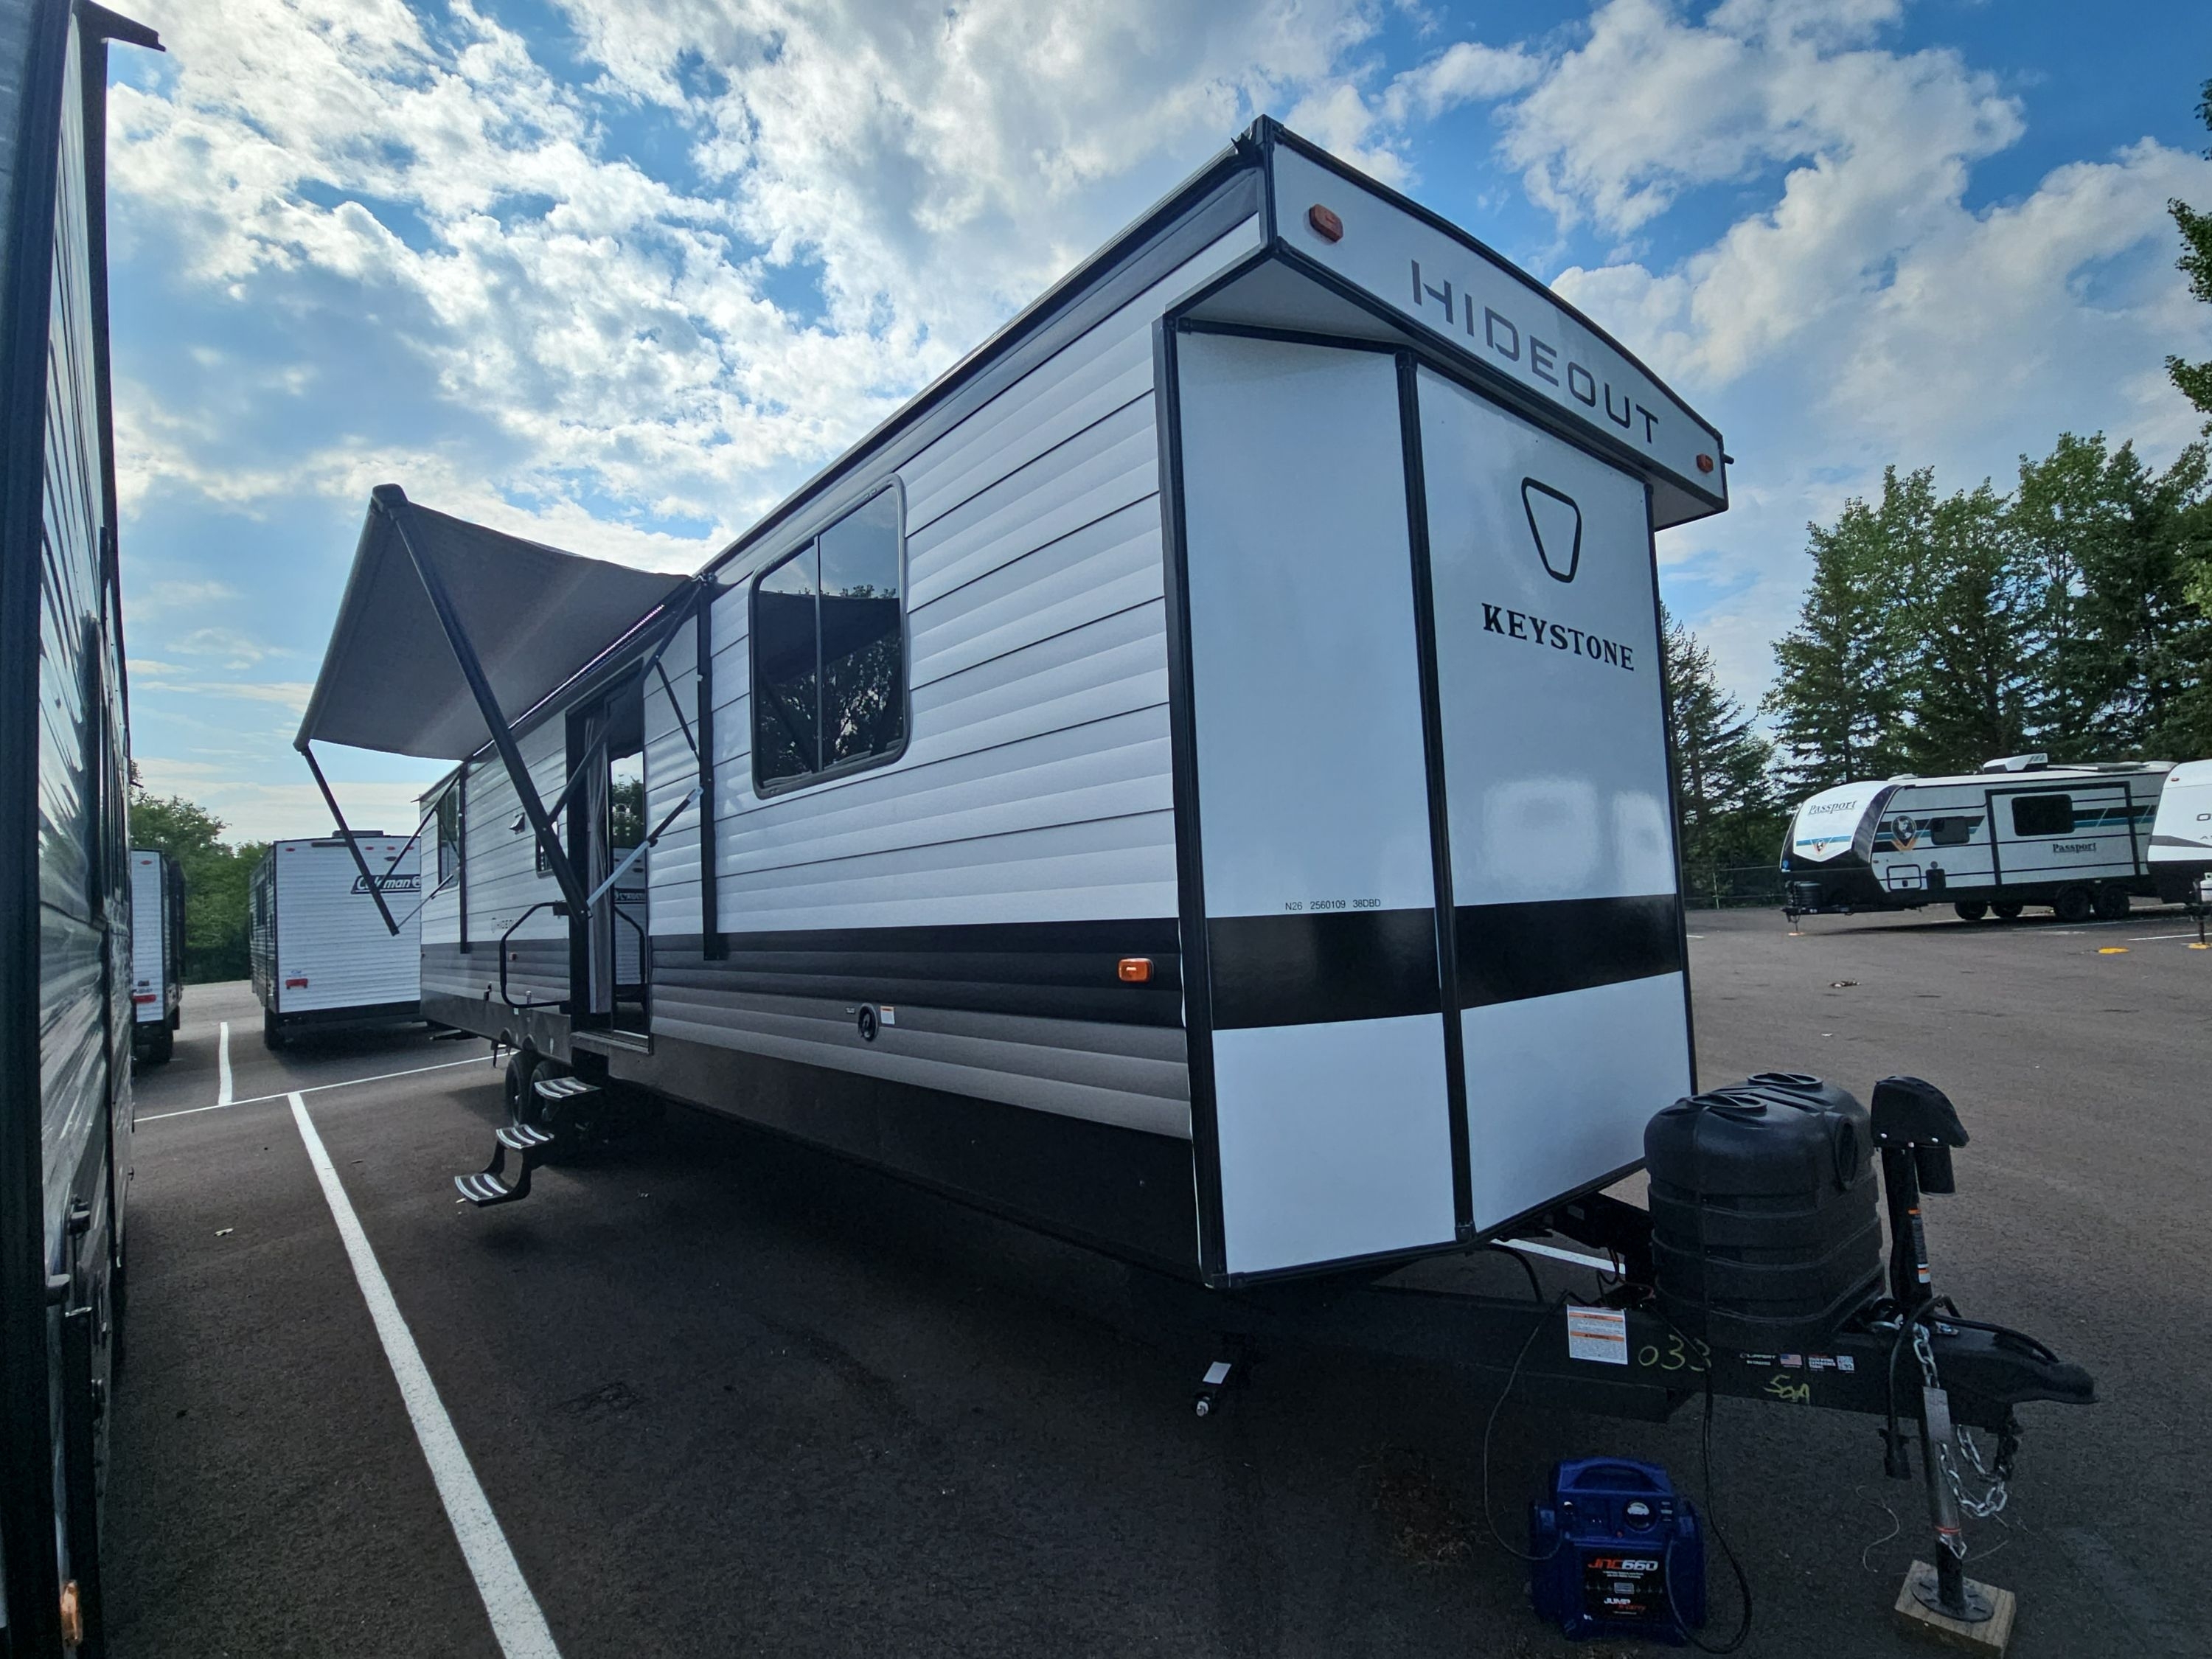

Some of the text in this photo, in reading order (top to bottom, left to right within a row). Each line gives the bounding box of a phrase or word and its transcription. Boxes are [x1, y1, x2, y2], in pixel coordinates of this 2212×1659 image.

[1411, 260, 1658, 443] HIDEOUT
[1481, 602, 1634, 672] KEYSTONE
[1809, 801, 1857, 815] Passport
[2053, 843, 2096, 853] Passport
[357, 877, 411, 889] Clman
[1285, 899, 1381, 911] N26 2560109 38DBD
